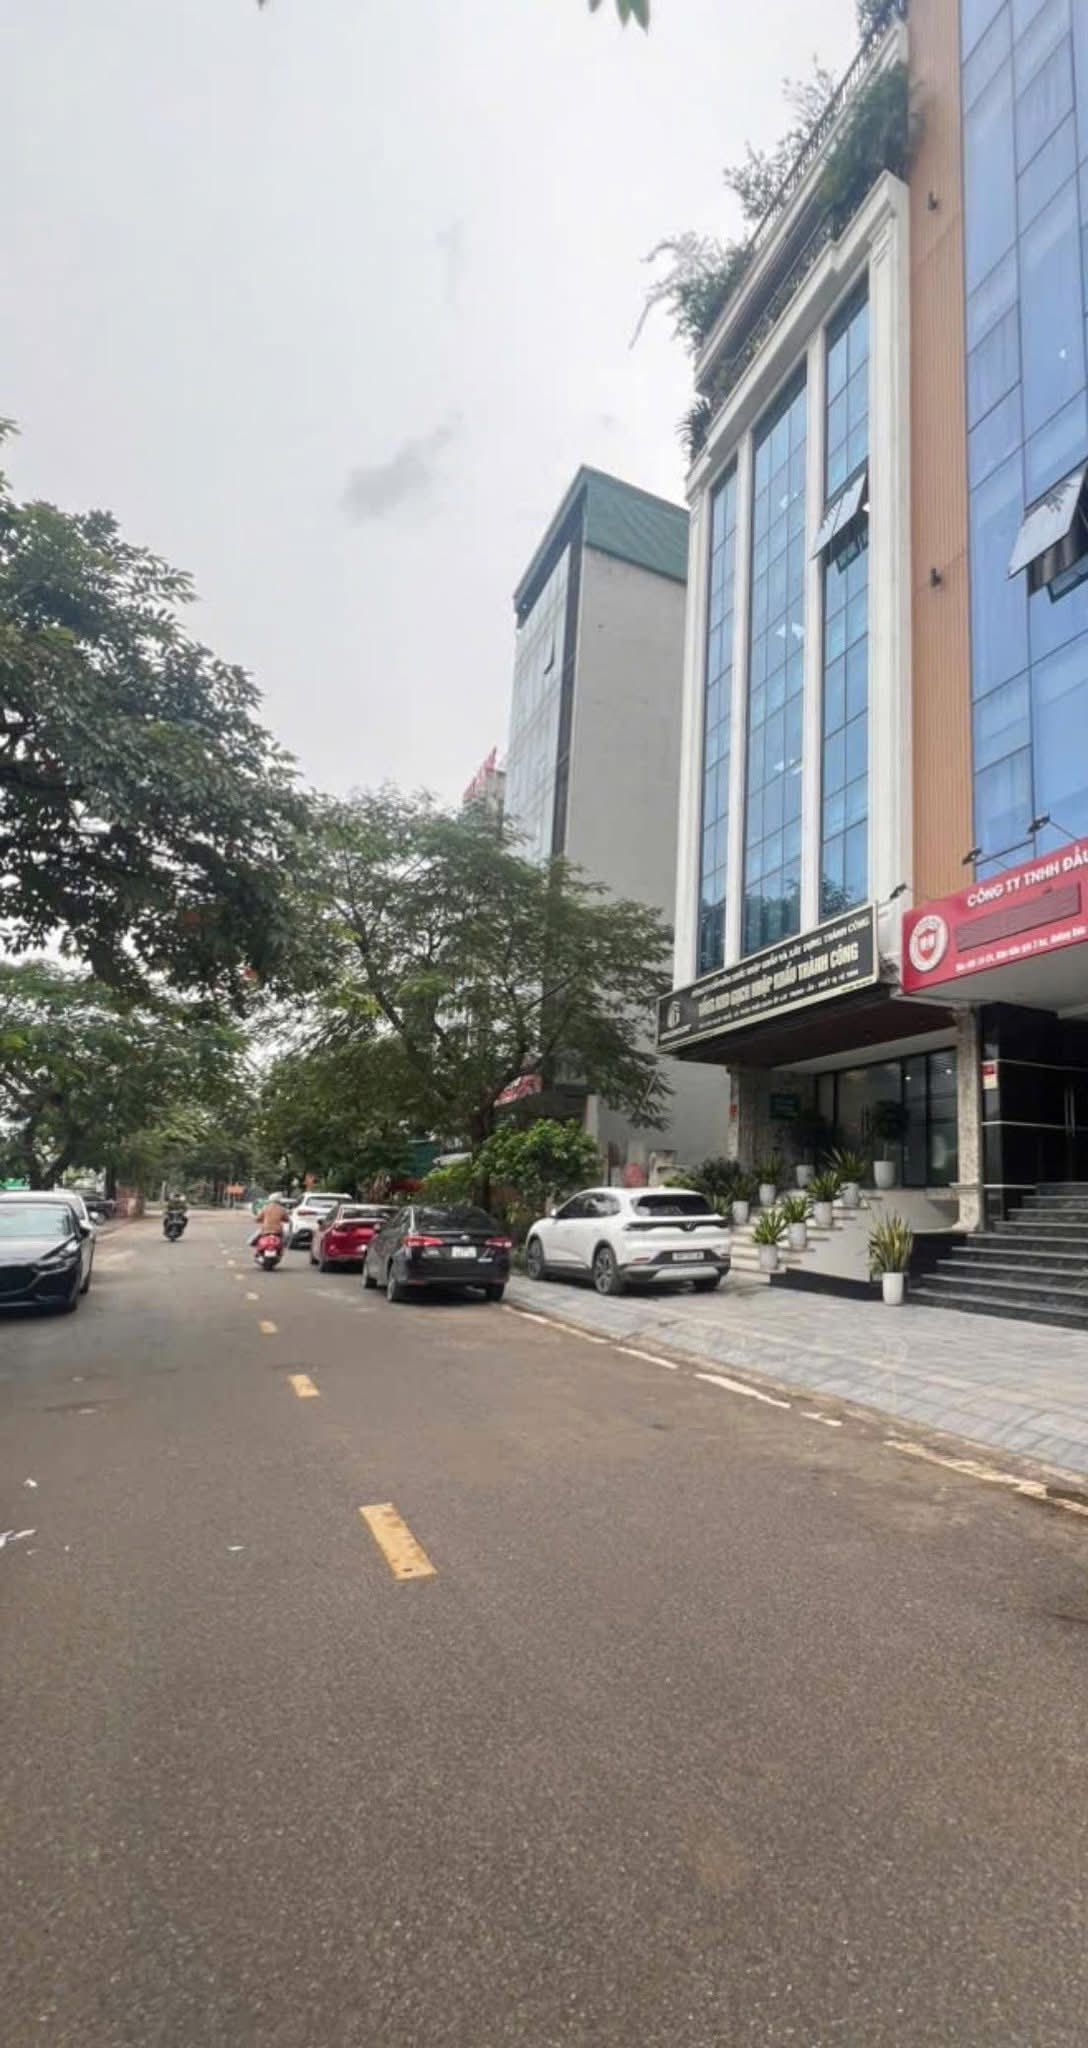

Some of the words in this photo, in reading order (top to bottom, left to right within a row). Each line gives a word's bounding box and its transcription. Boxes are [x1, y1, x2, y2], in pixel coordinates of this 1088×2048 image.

[967, 884, 1004, 908] CÔNG
[1006, 876, 1022, 893] TY
[1024, 861, 1060, 886] TNHH
[797, 952, 828, 981] THÀNH
[830, 941, 858, 968] CÔNG
